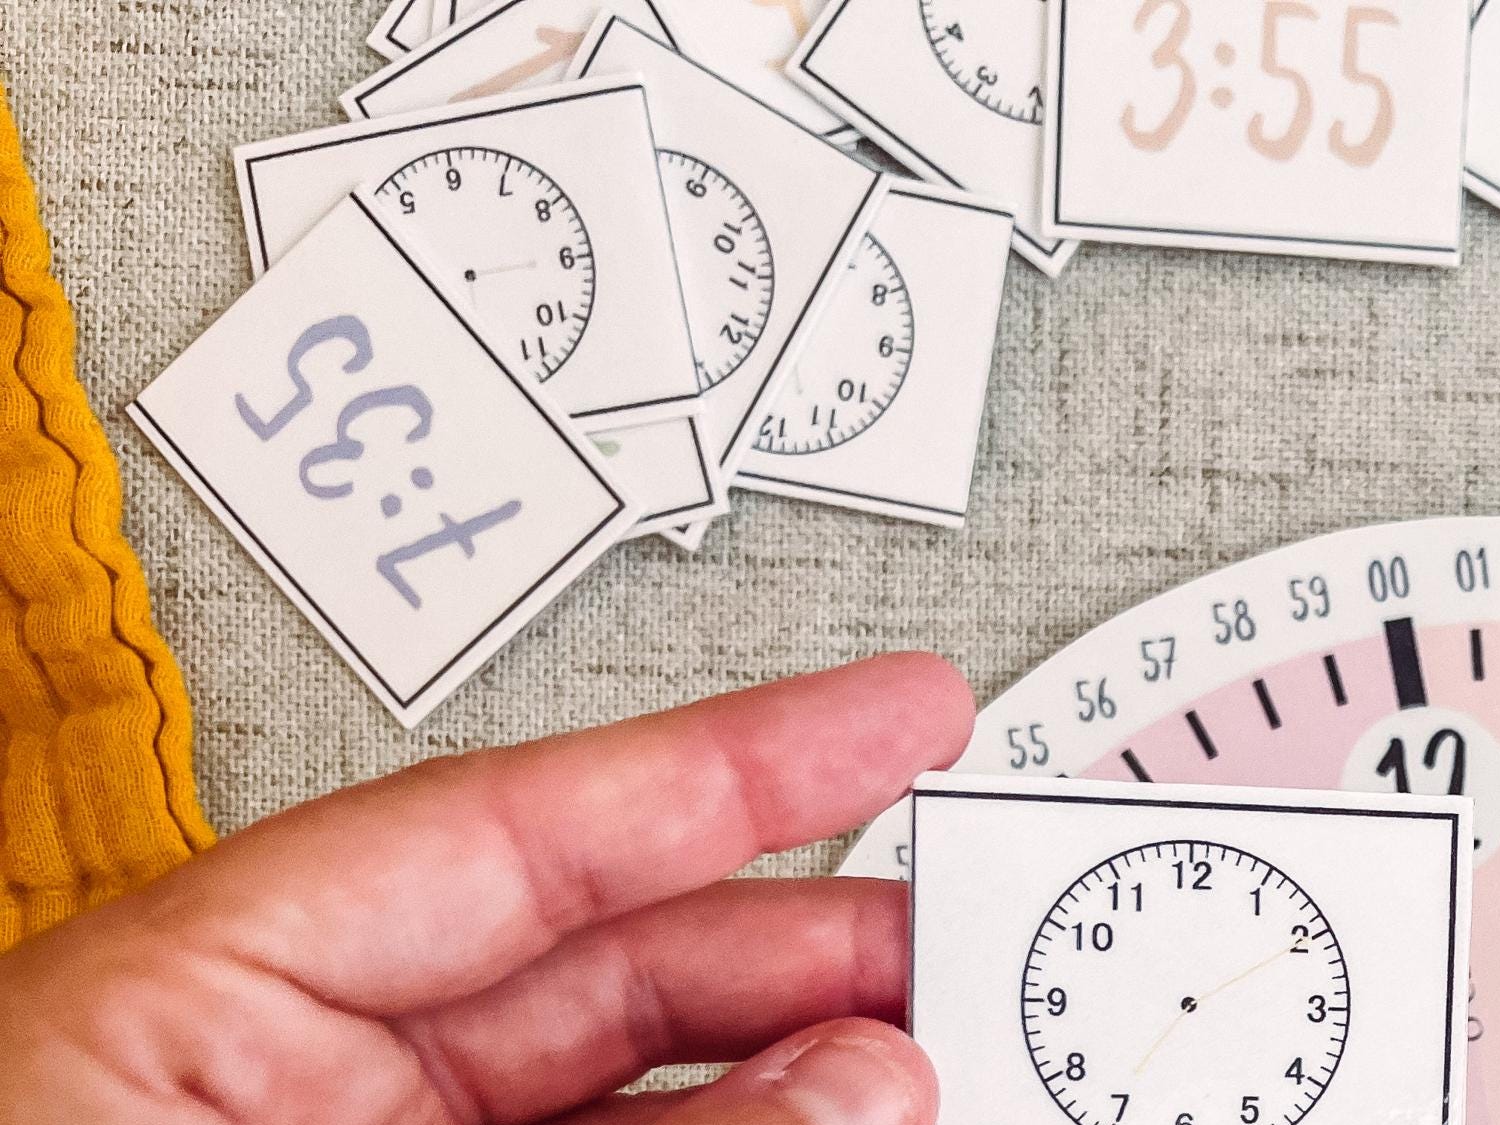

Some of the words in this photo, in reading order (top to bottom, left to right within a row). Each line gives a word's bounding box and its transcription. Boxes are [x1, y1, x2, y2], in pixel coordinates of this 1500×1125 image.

[1120, 0, 1399, 168] 3:55
[235, 313, 522, 608] 7:35
[1368, 555, 1410, 602] 00
[1454, 547, 1490, 592] 01
[1288, 575, 1331, 622] 59
[1212, 599, 1257, 645] 58
[1140, 636, 1176, 683] 57
[1074, 677, 1117, 723] 56
[1007, 723, 1049, 770] 55
[1172, 860, 1212, 890] 12
[1107, 882, 1142, 911] 11
[1250, 887, 1262, 916] 1
[1072, 922, 1114, 951] 10
[1290, 925, 1309, 953] 2
[1047, 988, 1067, 1016] 9
[1307, 995, 1327, 1023] 3
[1066, 1053, 1086, 1081] 8
[1285, 1057, 1306, 1085] 4
[1111, 1094, 1130, 1122] 7
[1241, 1096, 1260, 1124] 5
